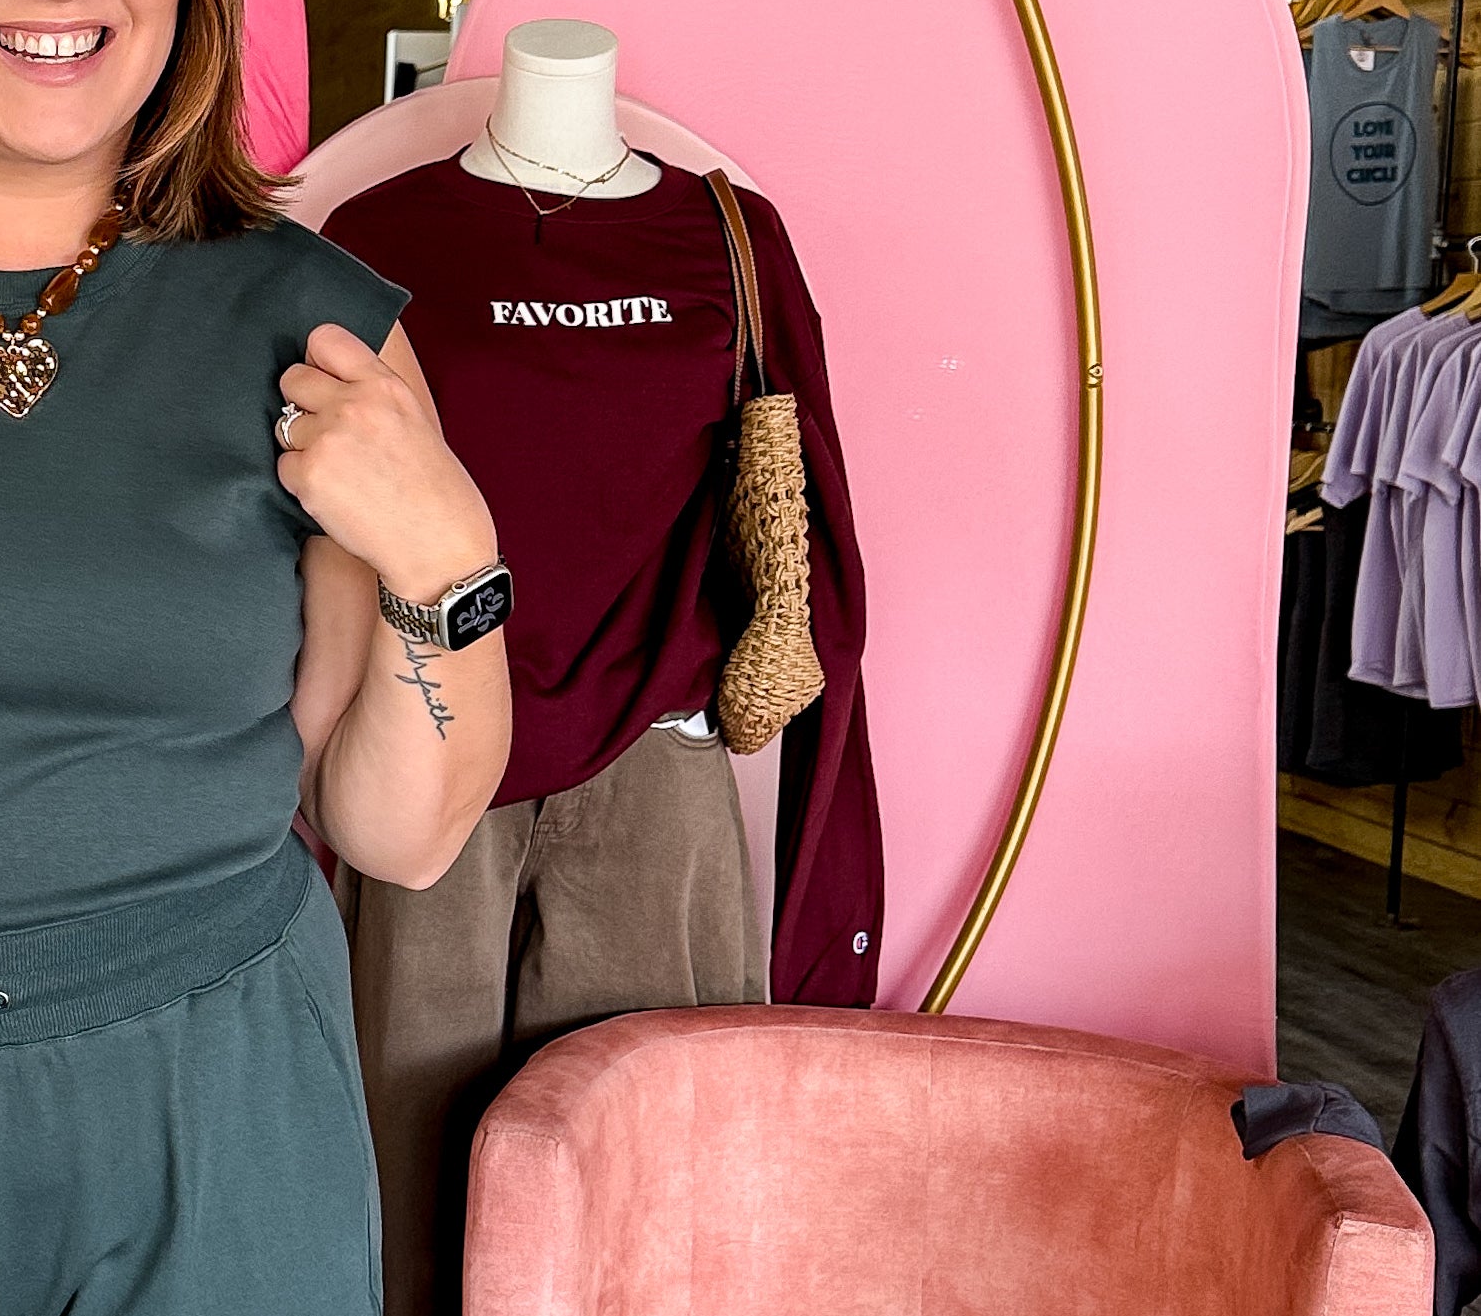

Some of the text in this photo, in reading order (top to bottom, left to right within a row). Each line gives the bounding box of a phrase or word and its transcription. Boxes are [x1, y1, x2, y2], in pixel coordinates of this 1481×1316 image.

[1351, 144, 1396, 161] YOUR
[1347, 166, 1398, 183] CIRCLE
[490, 296, 673, 327] FAVORITE
